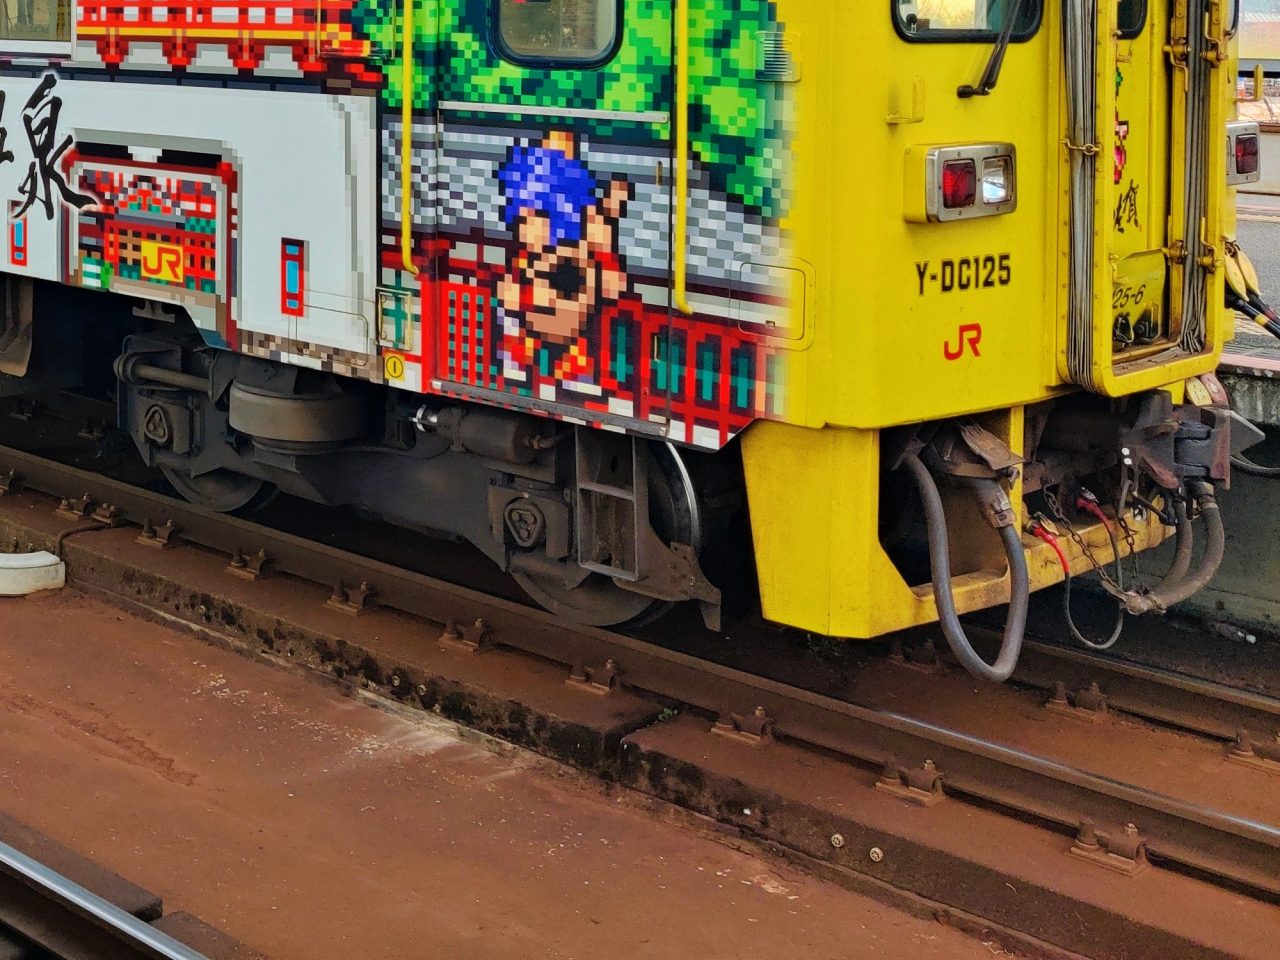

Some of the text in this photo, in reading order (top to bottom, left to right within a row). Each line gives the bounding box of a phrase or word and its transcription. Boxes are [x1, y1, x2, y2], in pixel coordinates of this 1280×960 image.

[143, 246, 180, 280] JR
[915, 252, 1011, 296] Y-DC125
[944, 323, 982, 360] JR
